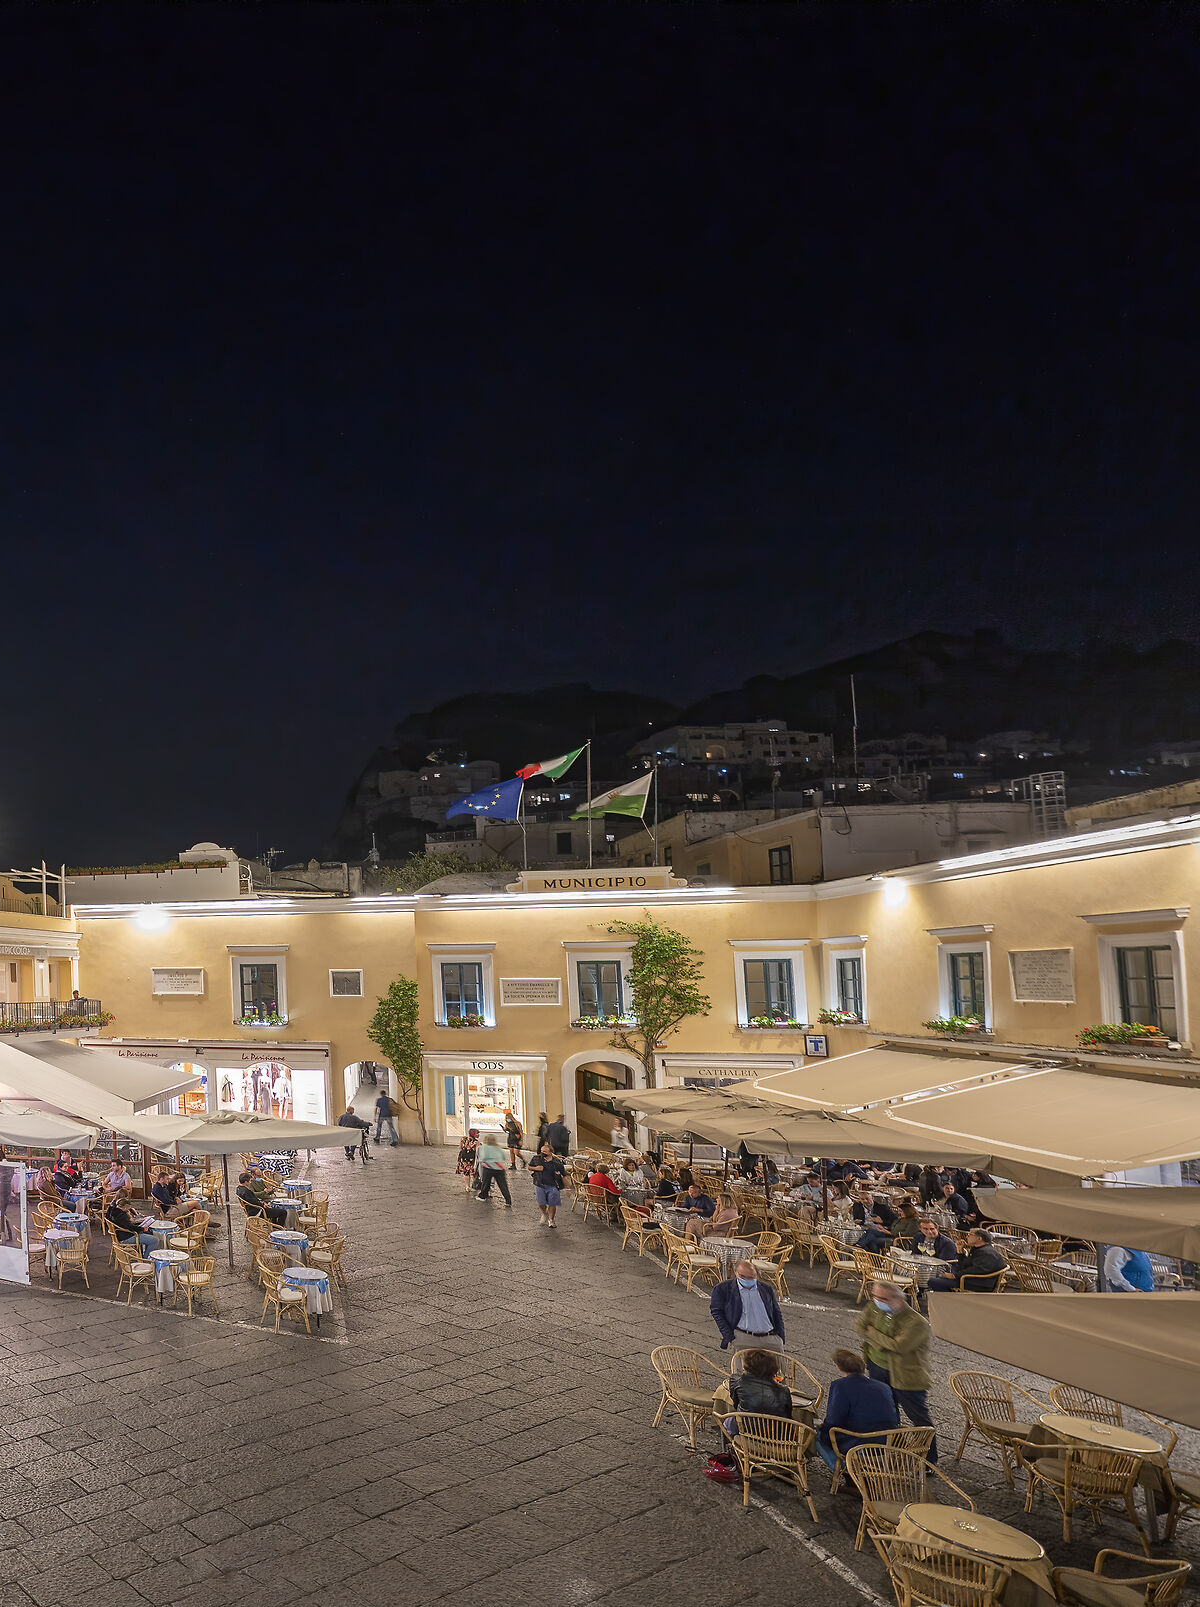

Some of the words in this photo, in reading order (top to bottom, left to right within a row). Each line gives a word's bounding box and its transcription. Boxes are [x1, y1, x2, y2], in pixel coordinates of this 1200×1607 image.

[543, 876, 647, 889] MUNICIPIO
[809, 1040, 823, 1051] T
[126, 1050, 159, 1058] Parisienne
[250, 1053, 286, 1061] Parisienne
[470, 1061, 505, 1070] TOD'S
